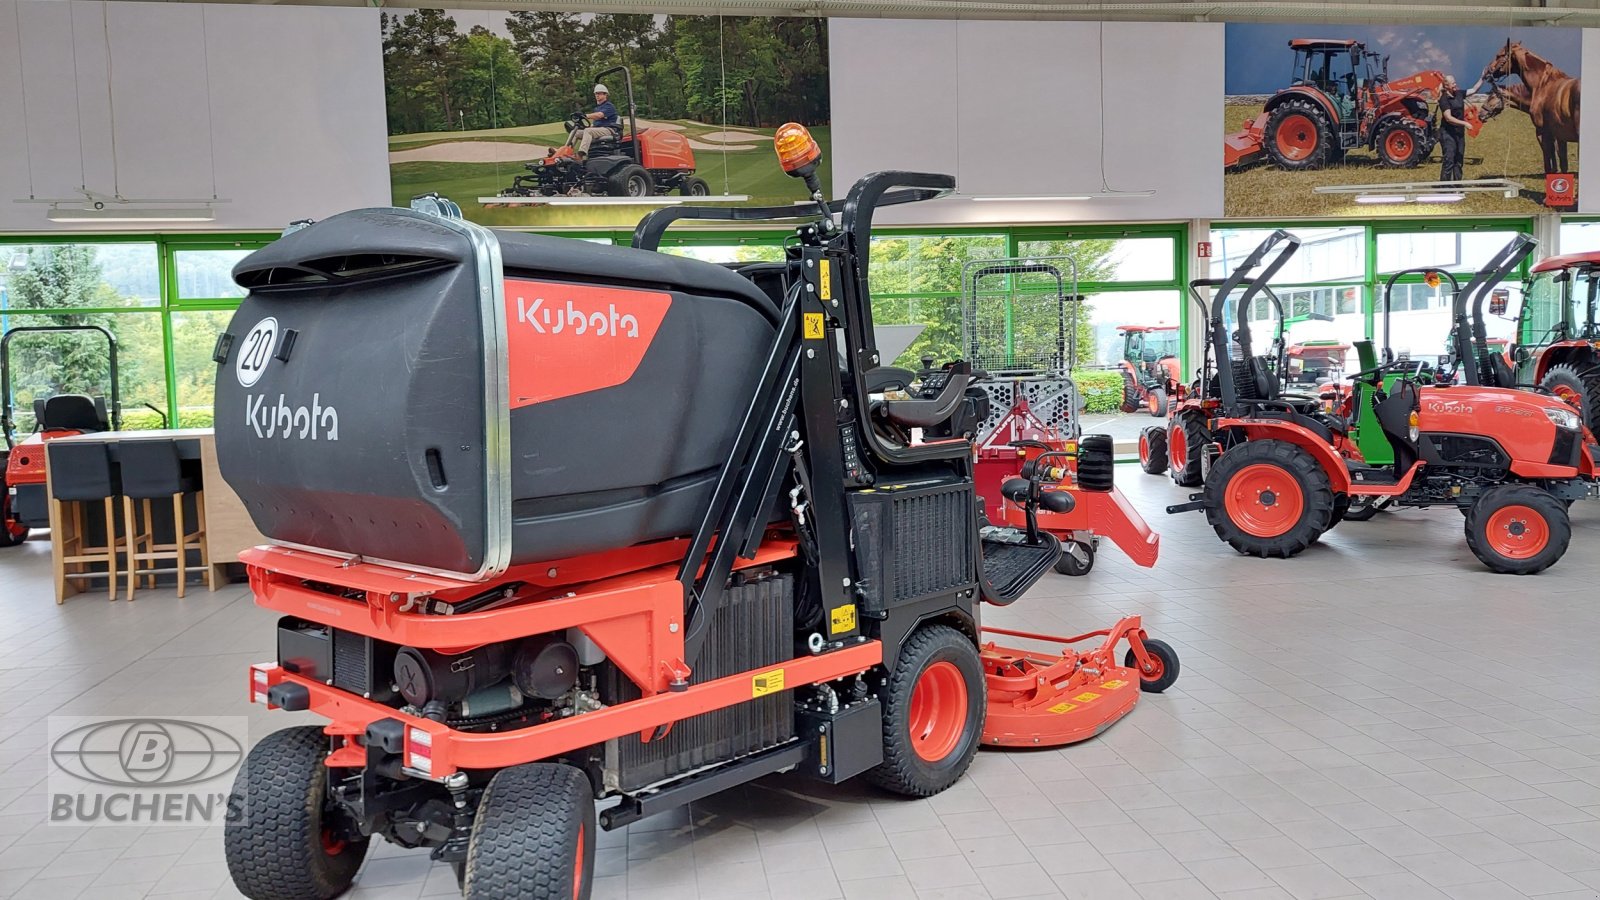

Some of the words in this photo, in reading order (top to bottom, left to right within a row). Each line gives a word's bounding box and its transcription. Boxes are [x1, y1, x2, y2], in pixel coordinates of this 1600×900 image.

[517, 296, 639, 338] Kubota
[241, 329, 273, 371] 20
[245, 392, 339, 441] Kubota
[1428, 402, 1473, 414] Kubota
